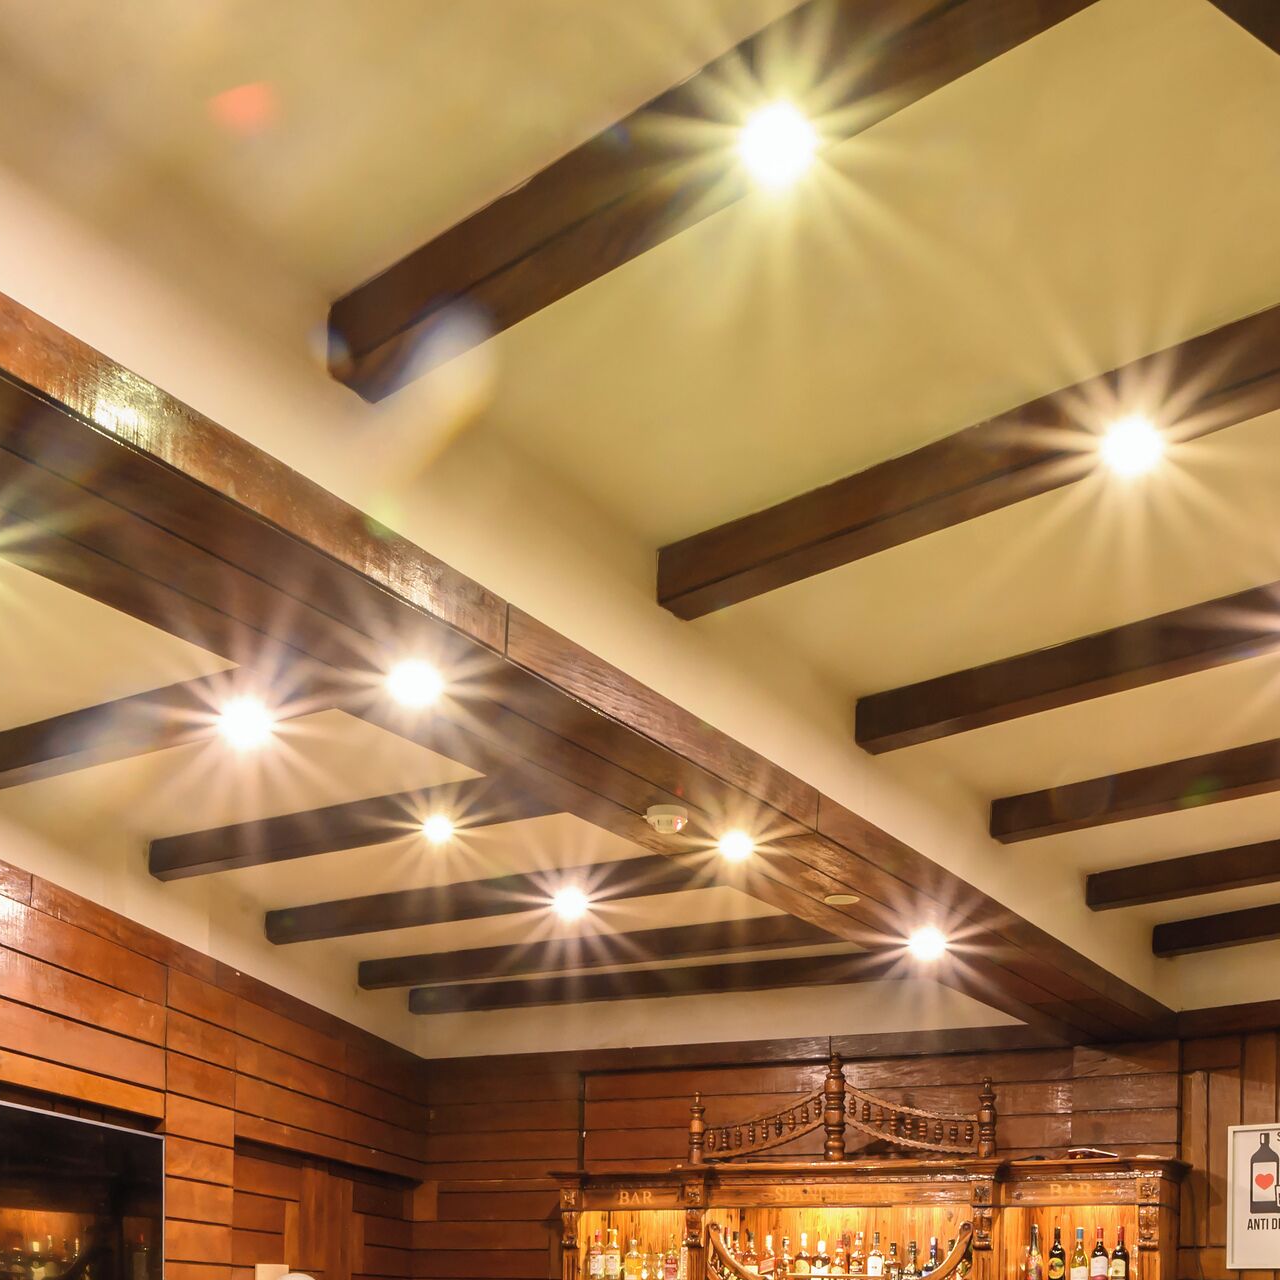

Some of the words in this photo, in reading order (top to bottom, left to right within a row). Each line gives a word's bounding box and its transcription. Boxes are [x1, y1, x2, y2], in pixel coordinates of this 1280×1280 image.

[1050, 1183, 1092, 1198] BAR
[619, 1191, 653, 1204] BAR
[1247, 1219, 1269, 1230] ANTI
